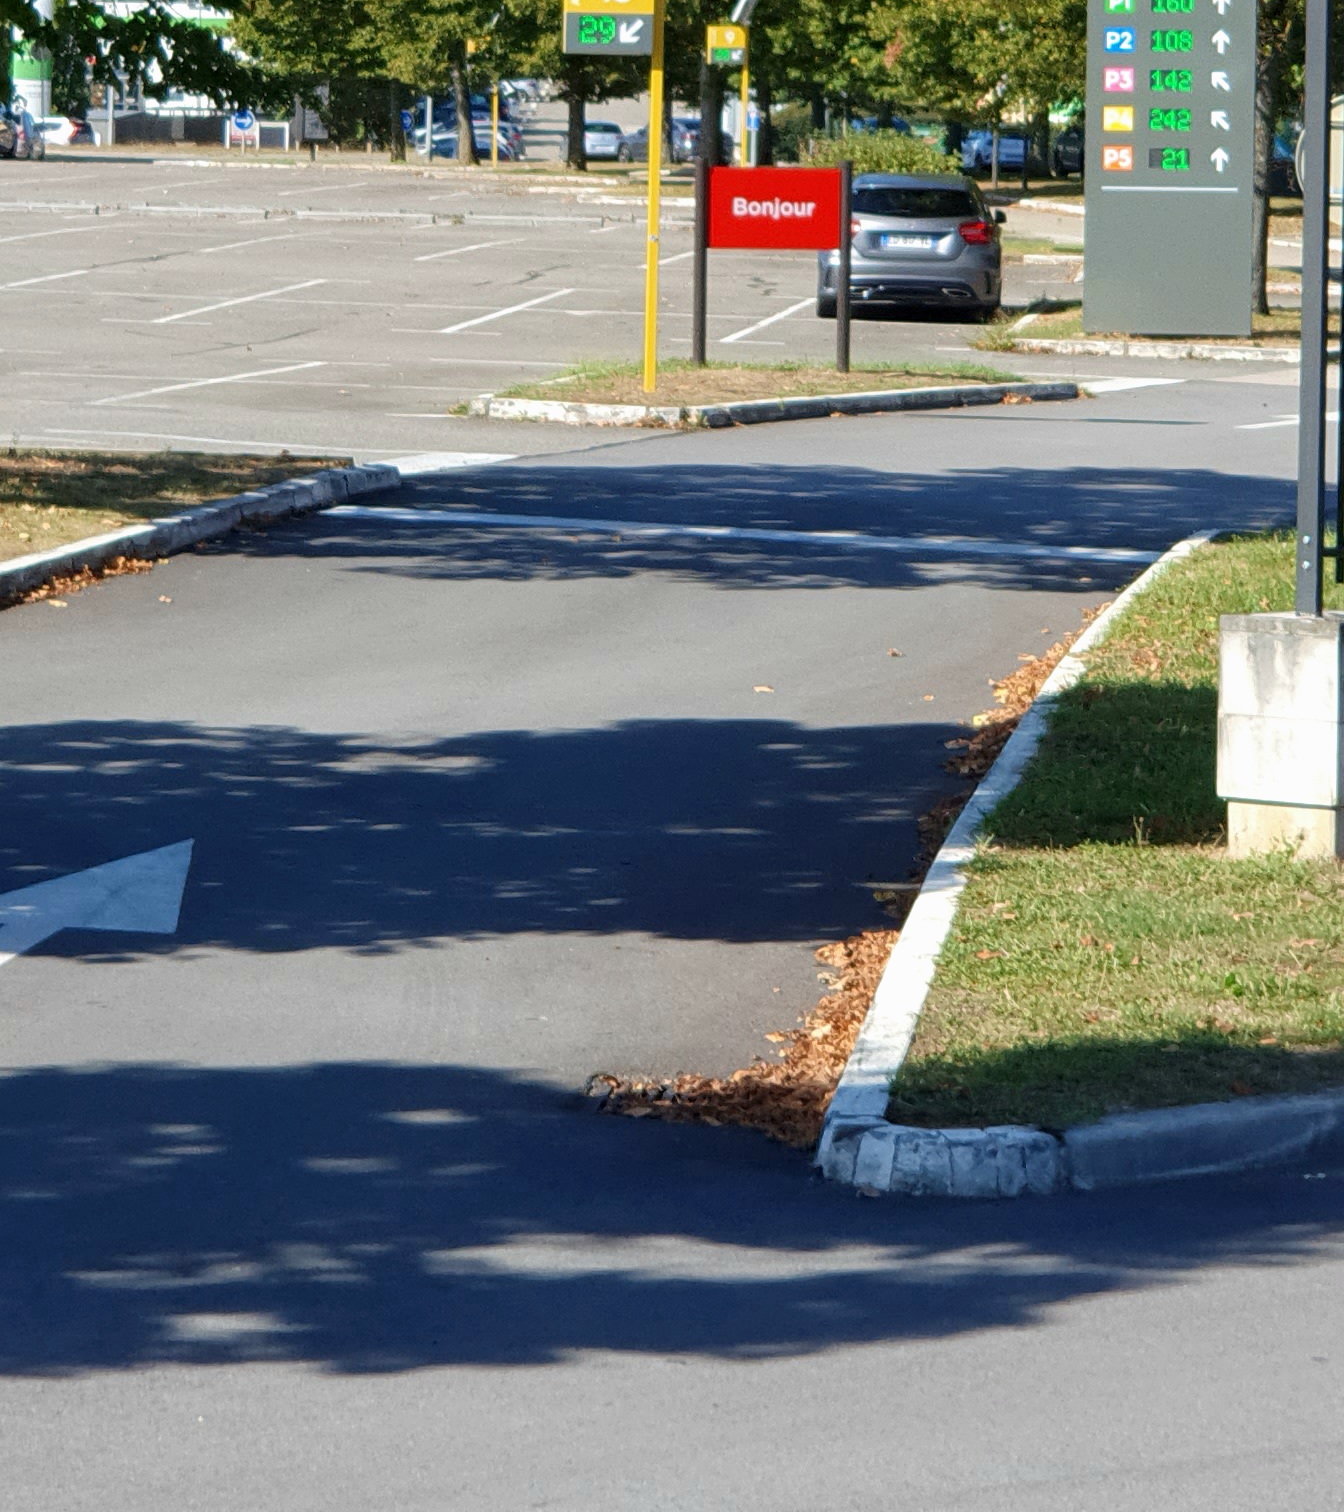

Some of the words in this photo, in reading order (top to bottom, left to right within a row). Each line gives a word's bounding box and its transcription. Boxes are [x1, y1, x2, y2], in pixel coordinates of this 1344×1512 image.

[579, 15, 616, 44] 29
[1106, 31, 1133, 50] P2
[1105, 70, 1133, 89] P3
[1151, 69, 1192, 92] 142
[1105, 108, 1132, 128] P4
[1150, 107, 1191, 131] 242
[1103, 149, 1131, 168] P5
[1161, 146, 1189, 170] 21
[732, 195, 816, 221] Bonjour
